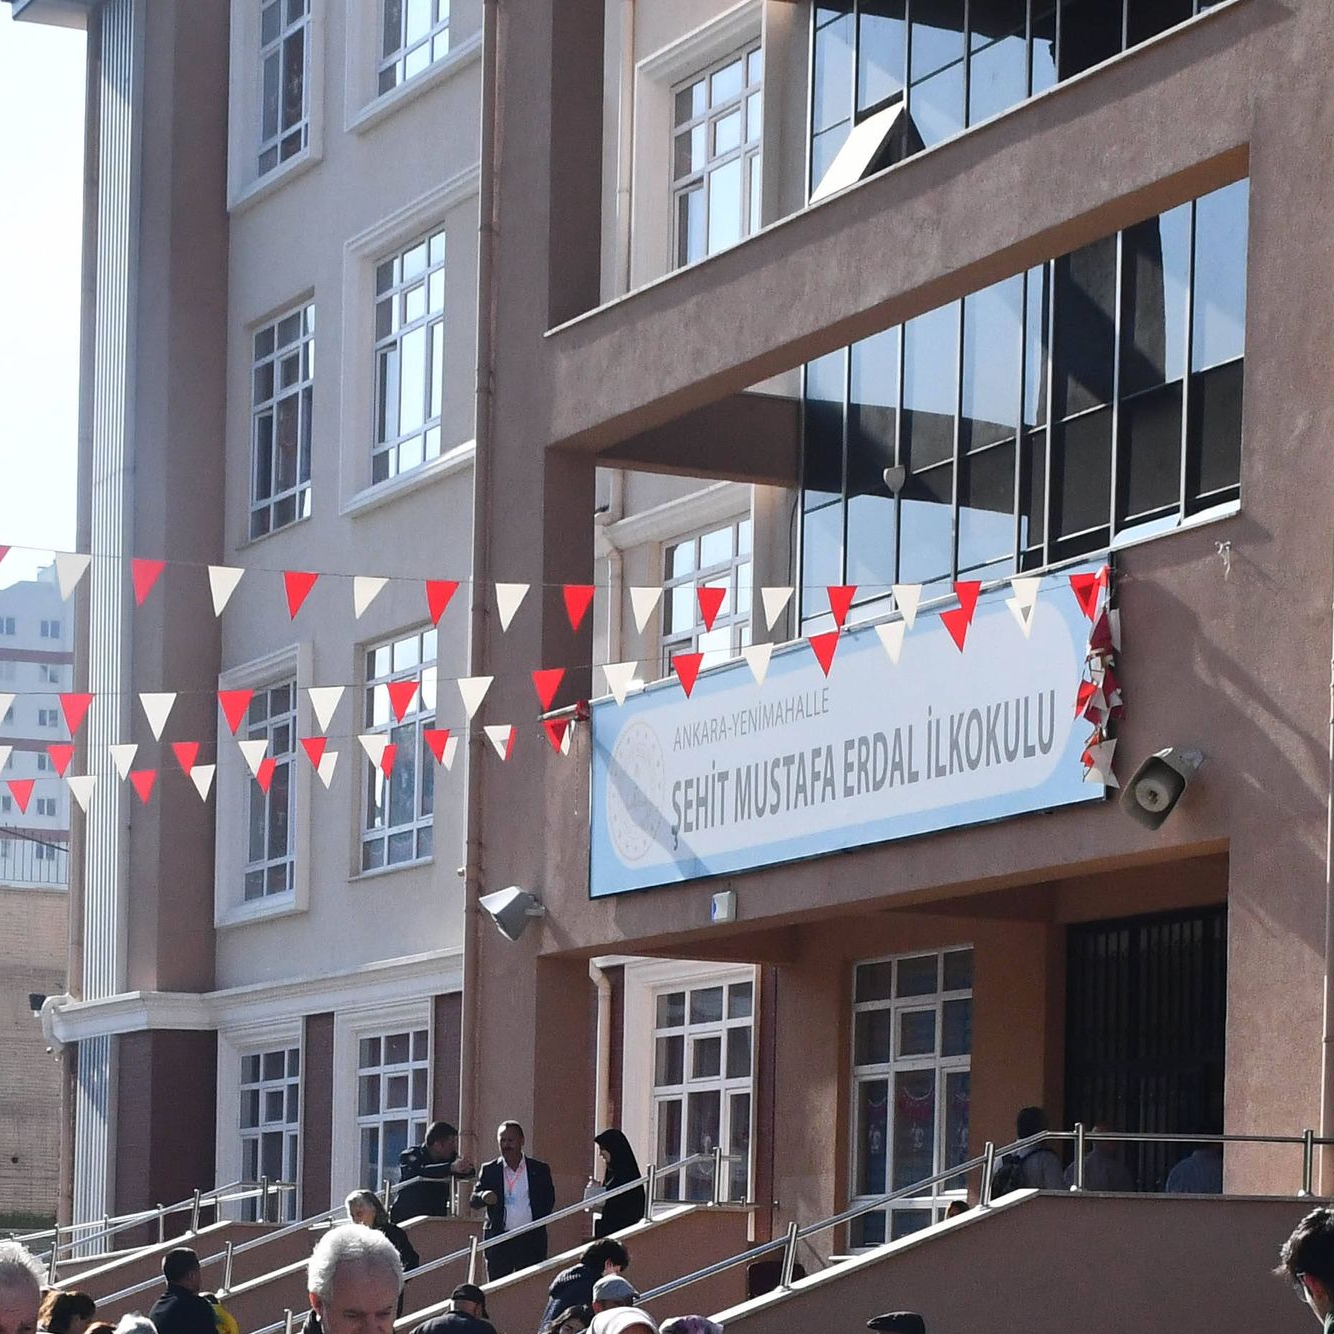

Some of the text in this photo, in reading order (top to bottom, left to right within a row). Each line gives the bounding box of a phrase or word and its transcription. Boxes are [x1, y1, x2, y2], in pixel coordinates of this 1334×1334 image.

[671, 689, 1056, 851] ŞEHİT MUSTAFA ERDAL İLKOKULU
[672, 687, 830, 752] ANKARA-YENİMAHALLE
